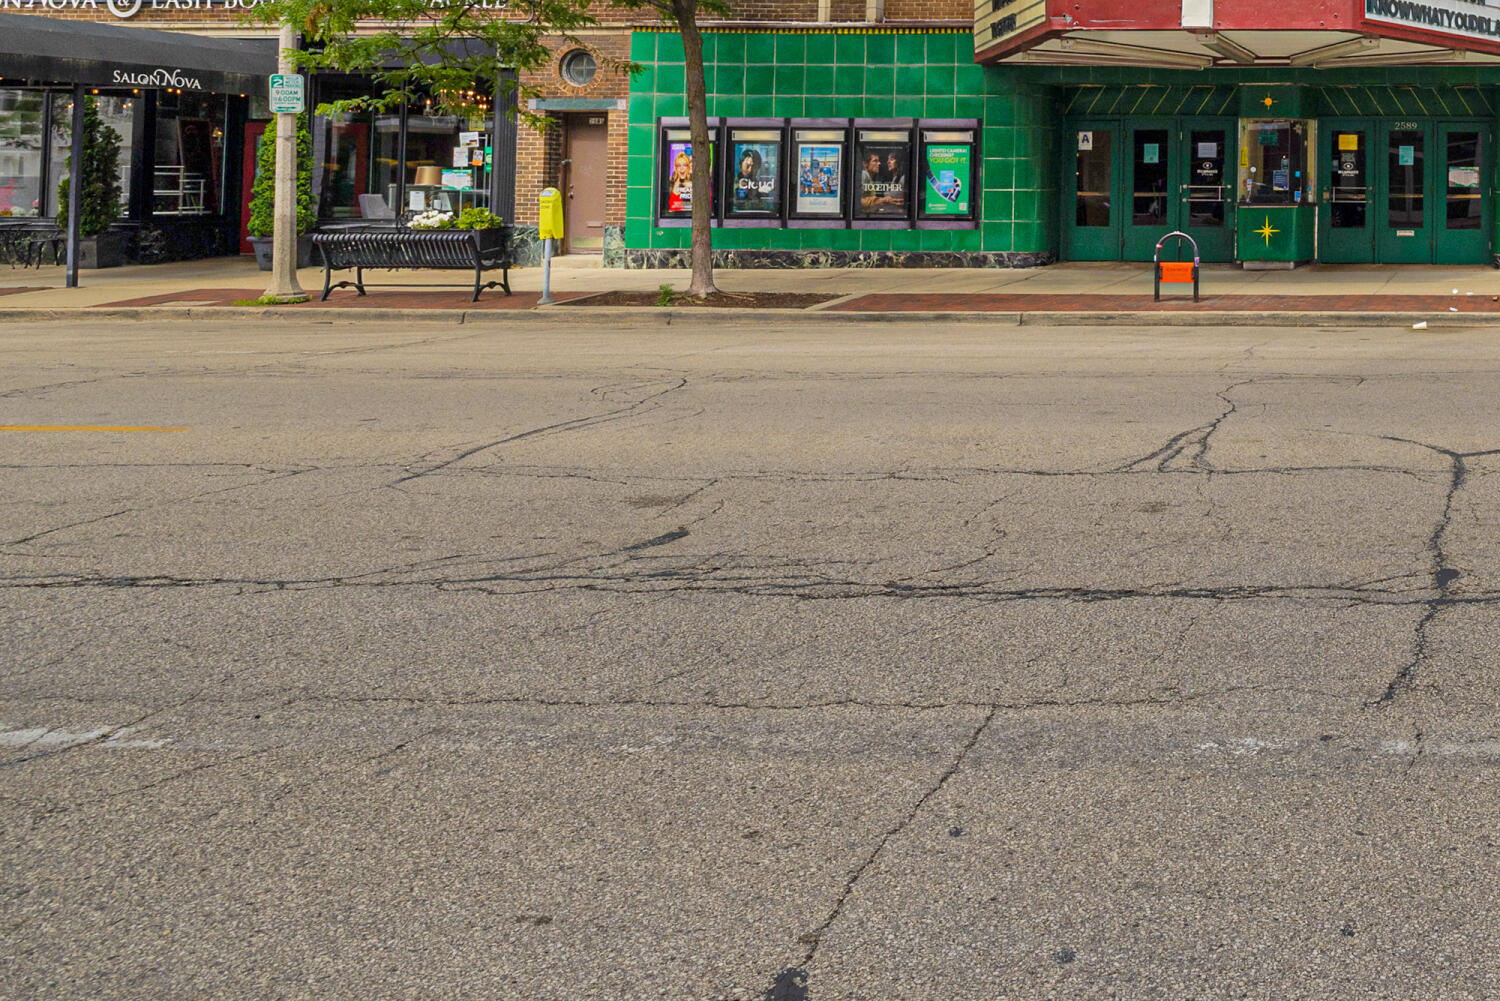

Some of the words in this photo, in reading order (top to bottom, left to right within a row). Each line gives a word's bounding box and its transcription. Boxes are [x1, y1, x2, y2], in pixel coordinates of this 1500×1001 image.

[273, 78, 283, 88] 2
[1394, 122, 1418, 130] 2589
[1081, 134, 1090, 143] A
